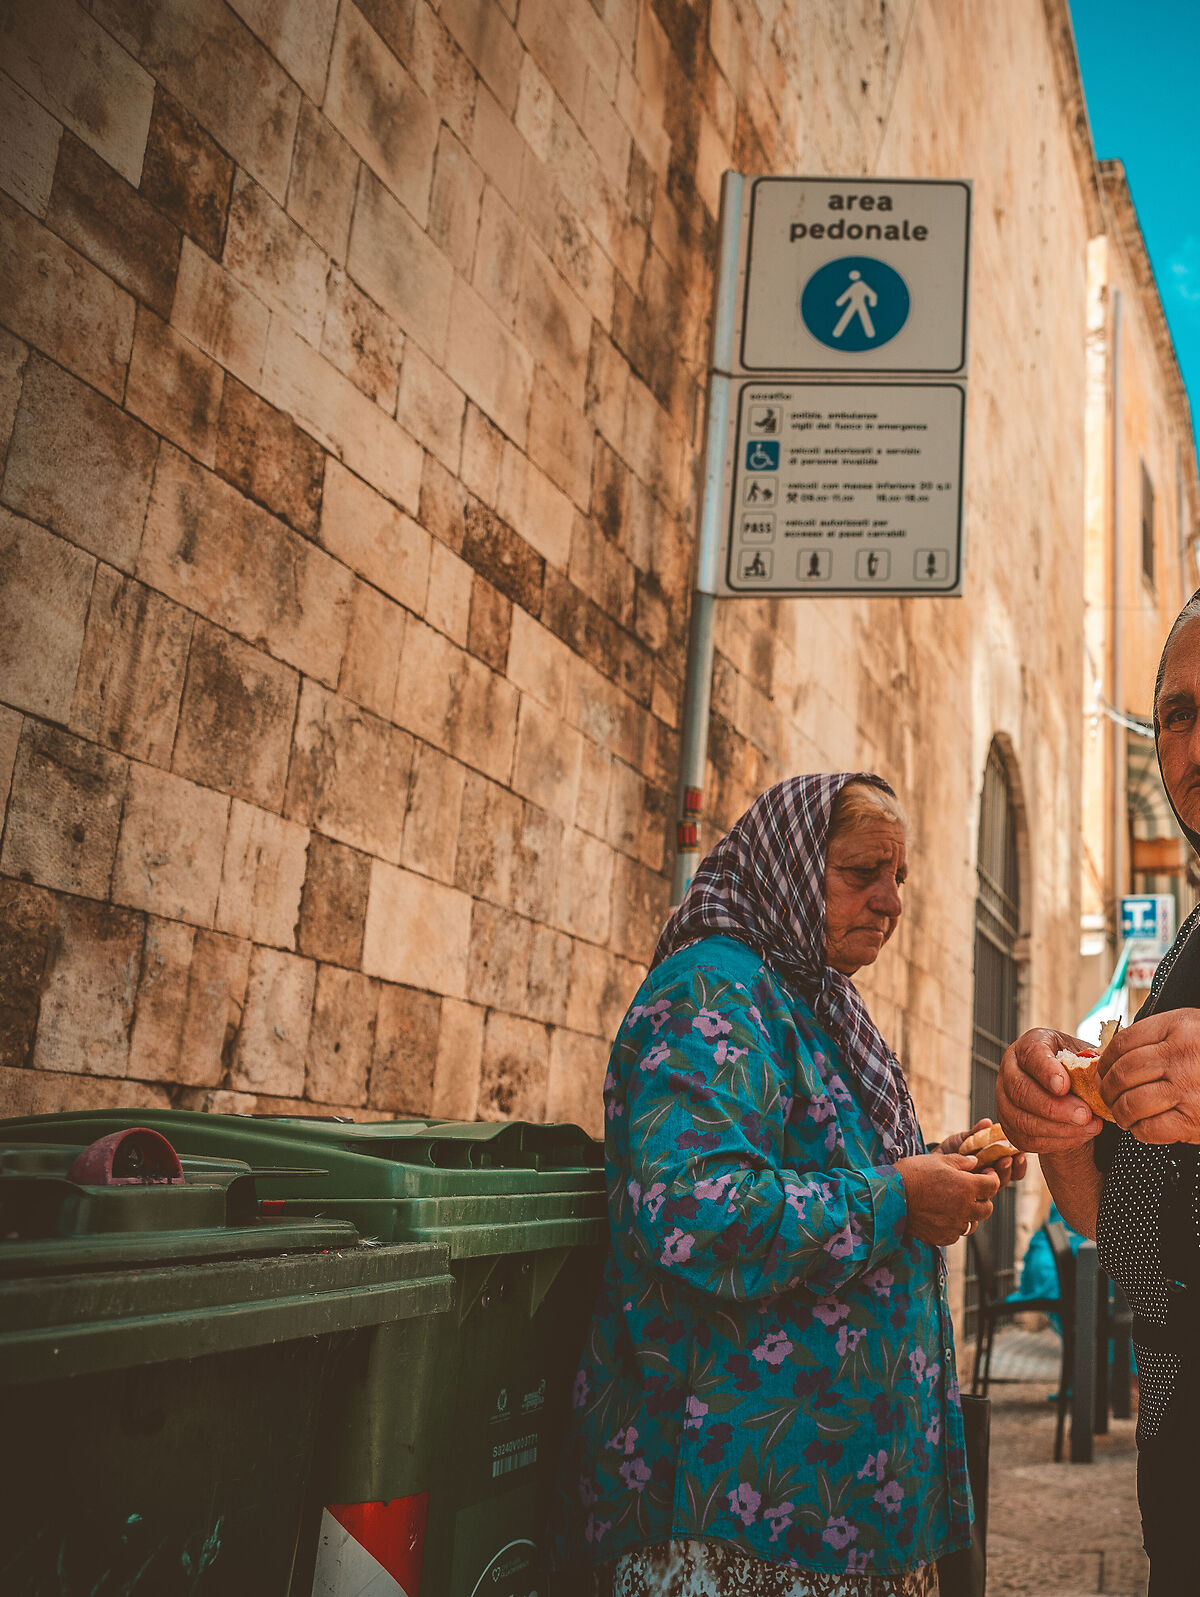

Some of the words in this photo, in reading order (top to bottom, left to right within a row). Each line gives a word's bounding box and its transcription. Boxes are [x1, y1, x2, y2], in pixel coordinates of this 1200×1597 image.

[828, 194, 893, 211] area
[790, 219, 928, 242] pedonale
[835, 423, 862, 432] fuoco
[877, 424, 928, 433] emergenza
[886, 447, 921, 456] servizio
[789, 457, 797, 466] di
[743, 521, 772, 534] PASS
[872, 519, 889, 529] per
